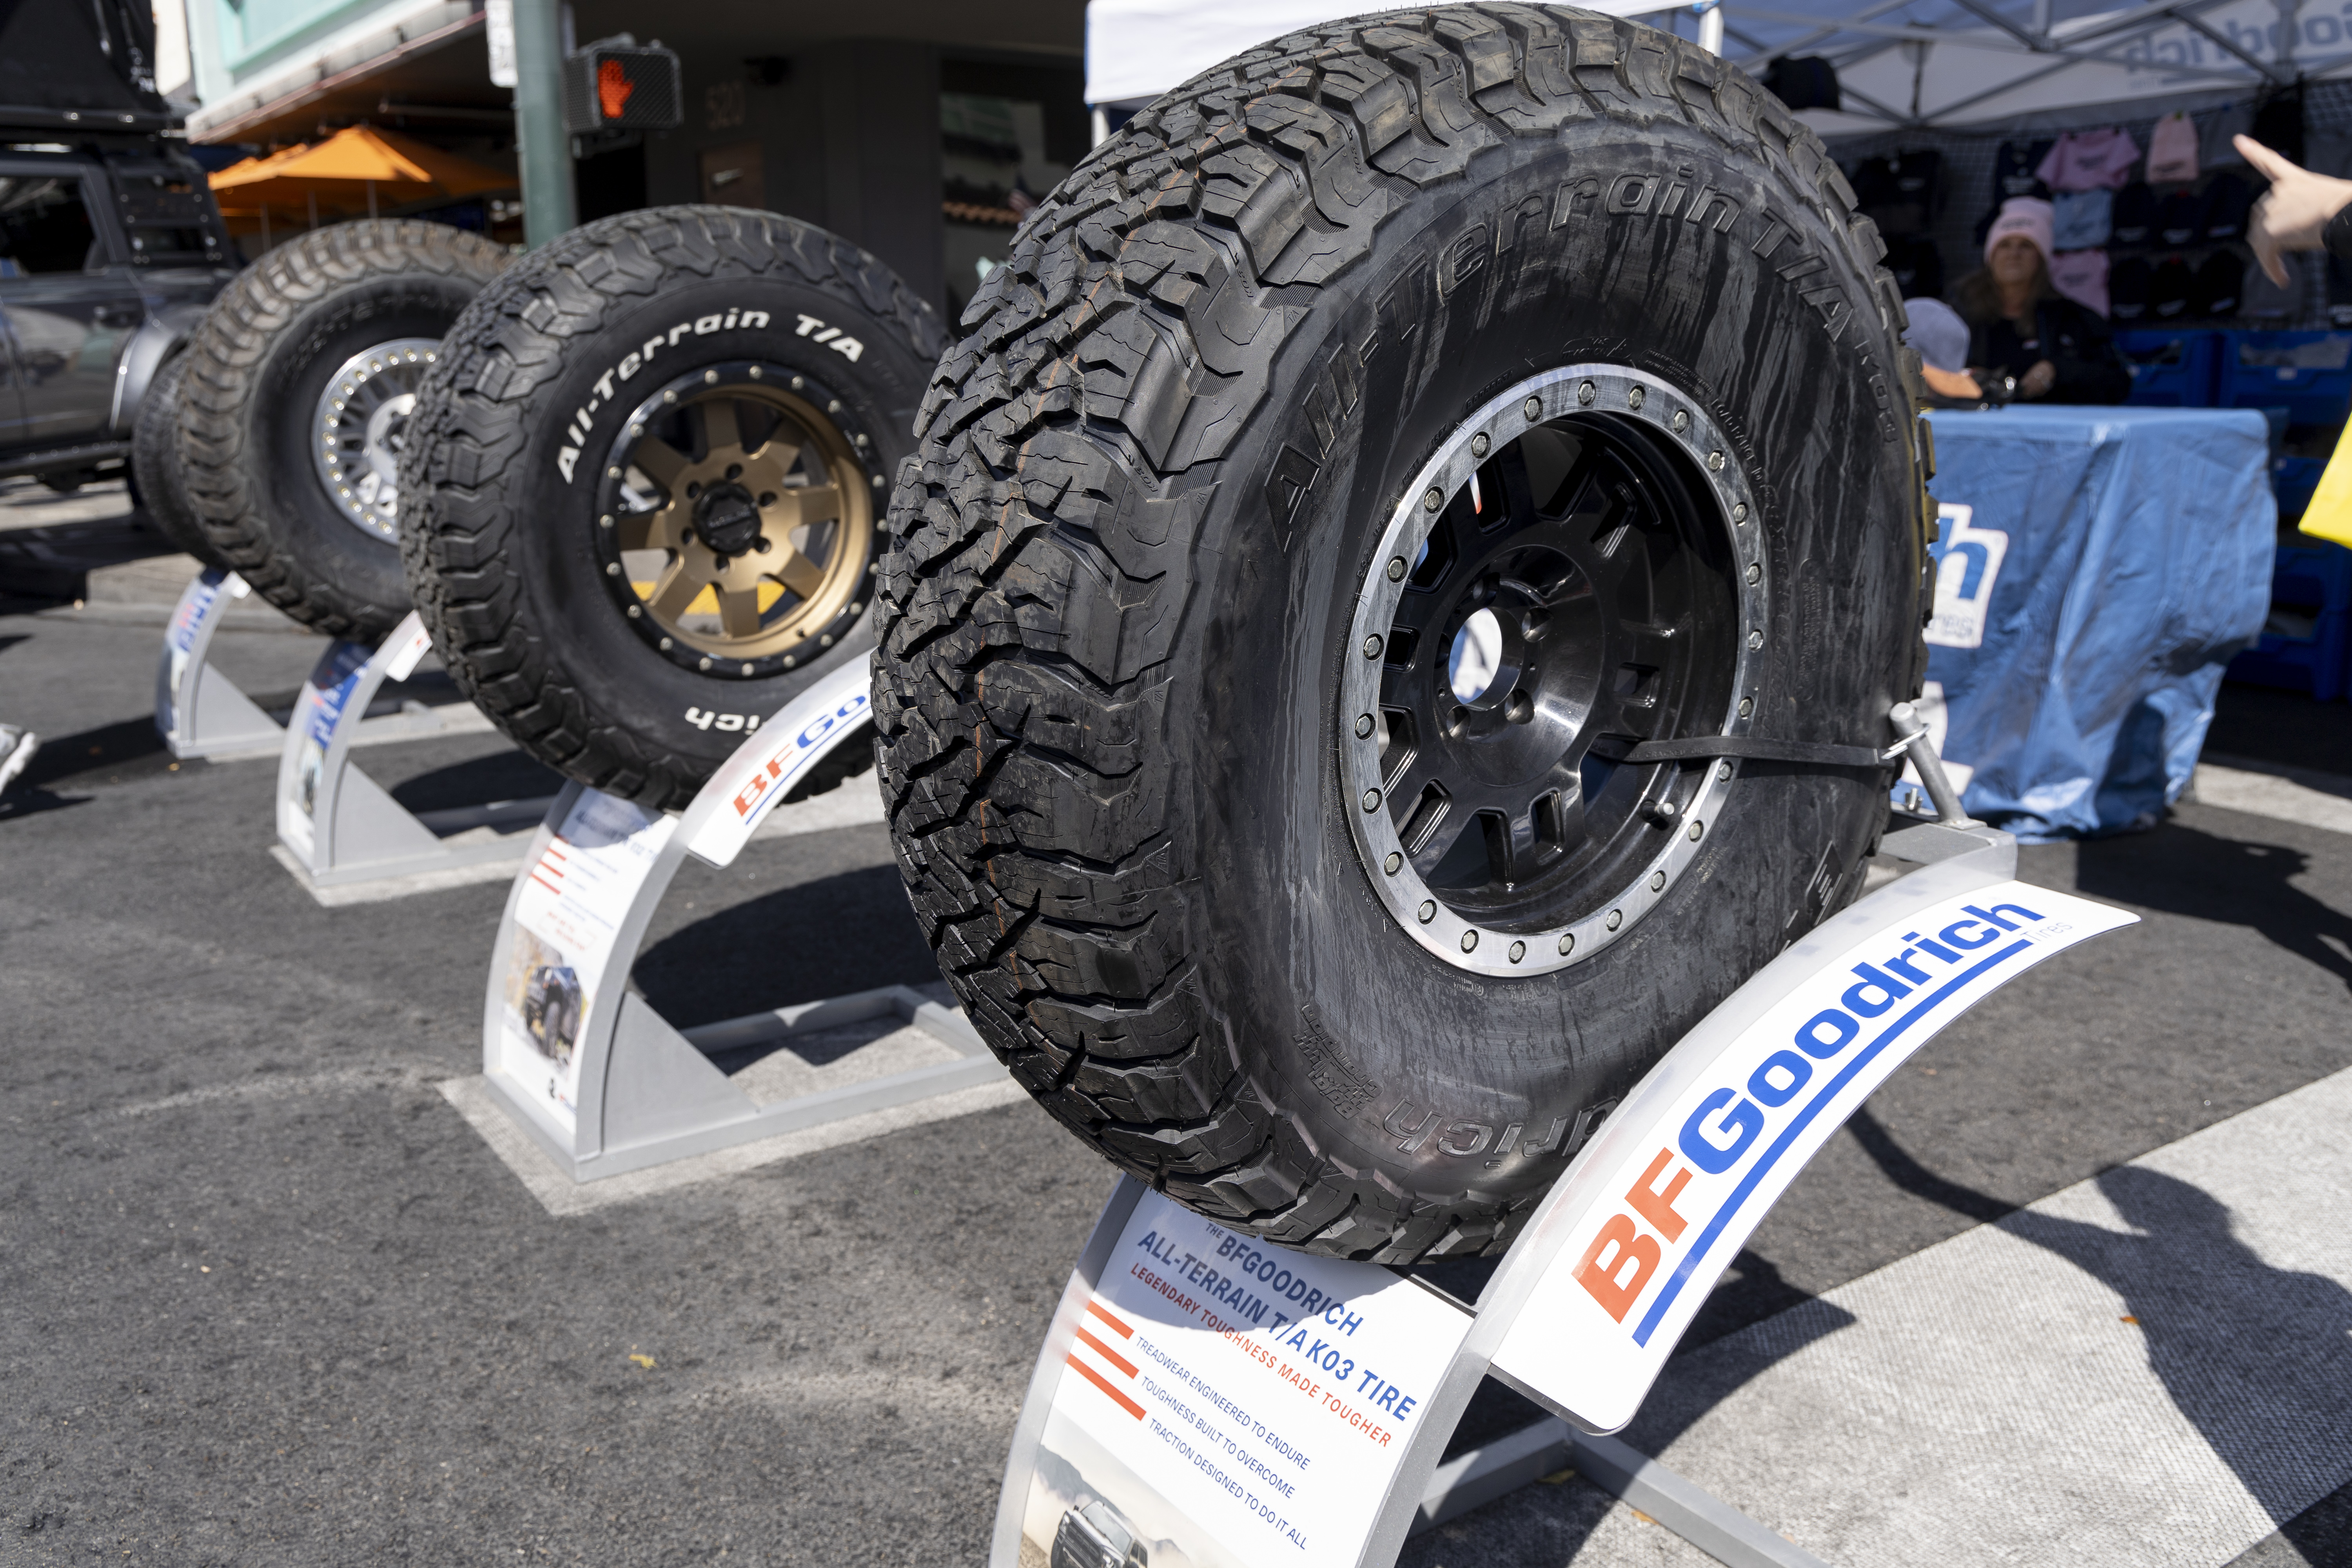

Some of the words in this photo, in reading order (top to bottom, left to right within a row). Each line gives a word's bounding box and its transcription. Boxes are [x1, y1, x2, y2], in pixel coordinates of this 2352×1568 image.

[1264, 166, 1740, 557] All-Terrain
[1751, 203, 1854, 343] T/A
[1287, 310, 1300, 324] T/A
[556, 307, 770, 484] All-Terrain
[795, 313, 864, 363] T/A
[1195, 492, 1208, 506] T/A
[733, 689, 871, 817] BFGo
[1645, 749, 1686, 758] CRACKED
[2020, 922, 2073, 942] Tires
[1300, 1002, 1384, 1101] Champion
[1311, 1076, 1359, 1120] Baja
[1571, 902, 2046, 1325] BFGoodrich
[1205, 1223, 1225, 1239] THE
[1216, 1235, 1364, 1336] BFGOODRICH
[1131, 1262, 1201, 1315] LEGENDARY
[1200, 1309, 1277, 1368] TOUGHNESS
[1278, 1363, 1321, 1398] MADE
[1322, 1392, 1392, 1448] TOUGHER
[1137, 1230, 1270, 1325] ALL-TERRAIN
[1269, 1312, 1308, 1352] T/A
[1357, 1369, 1417, 1422] TIRE
[1136, 1336, 1190, 1383] TREADWEAR
[1189, 1376, 1251, 1426] ENGINEERED
[1251, 1421, 1266, 1438] TO
[1265, 1432, 1310, 1471] ENDURE
[1141, 1376, 1196, 1424] TOUGHNESS
[1195, 1417, 1223, 1443] BUILT
[1222, 1438, 1236, 1454] TO
[1237, 1450, 1296, 1499] OVERCOME
[1149, 1417, 1195, 1460] TRACTION
[1193, 1454, 1243, 1498] DESIGNED
[1244, 1492, 1259, 1510] TO
[1258, 1505, 1276, 1523] DO
[1275, 1518, 1289, 1532] IT
[1287, 1528, 1307, 1551] ALL
